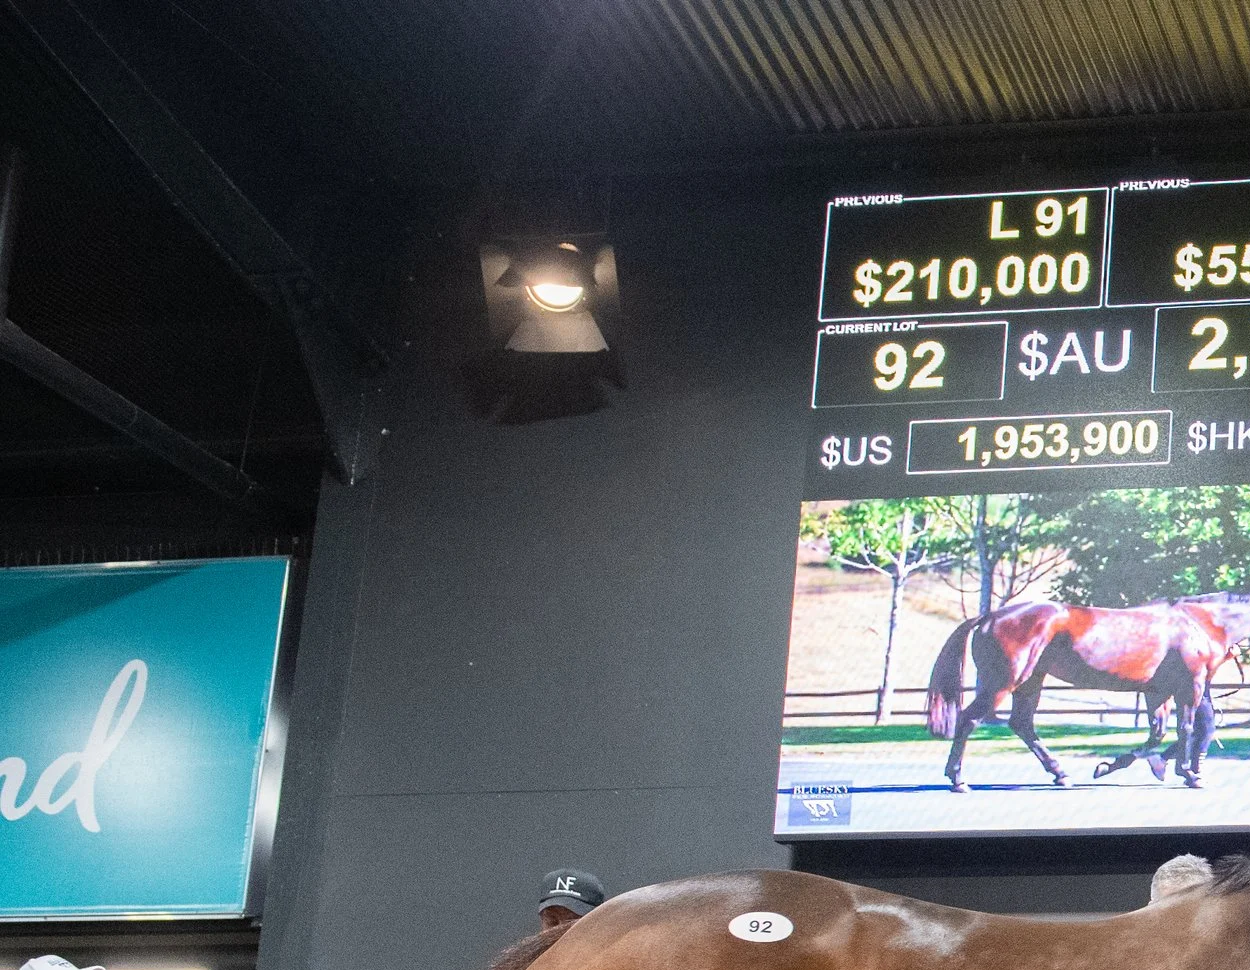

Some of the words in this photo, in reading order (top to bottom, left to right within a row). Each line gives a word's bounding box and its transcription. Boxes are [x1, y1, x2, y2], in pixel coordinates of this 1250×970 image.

[1119, 177, 1191, 191] PREVIOUS
[834, 193, 904, 208] PREVIOUS
[990, 201, 1020, 239] L
[1035, 197, 1088, 237] 91
[853, 251, 1091, 306] $210,000
[825, 322, 892, 335] CURRENT
[892, 321, 919, 331] LOT
[874, 340, 946, 391] 92
[1017, 329, 1132, 382] $AU
[820, 435, 893, 467] $US
[957, 417, 1159, 464] 1,953,900
[793, 784, 849, 795] BLUESKY
[555, 876, 577, 891] NF
[748, 919, 773, 934] 92
